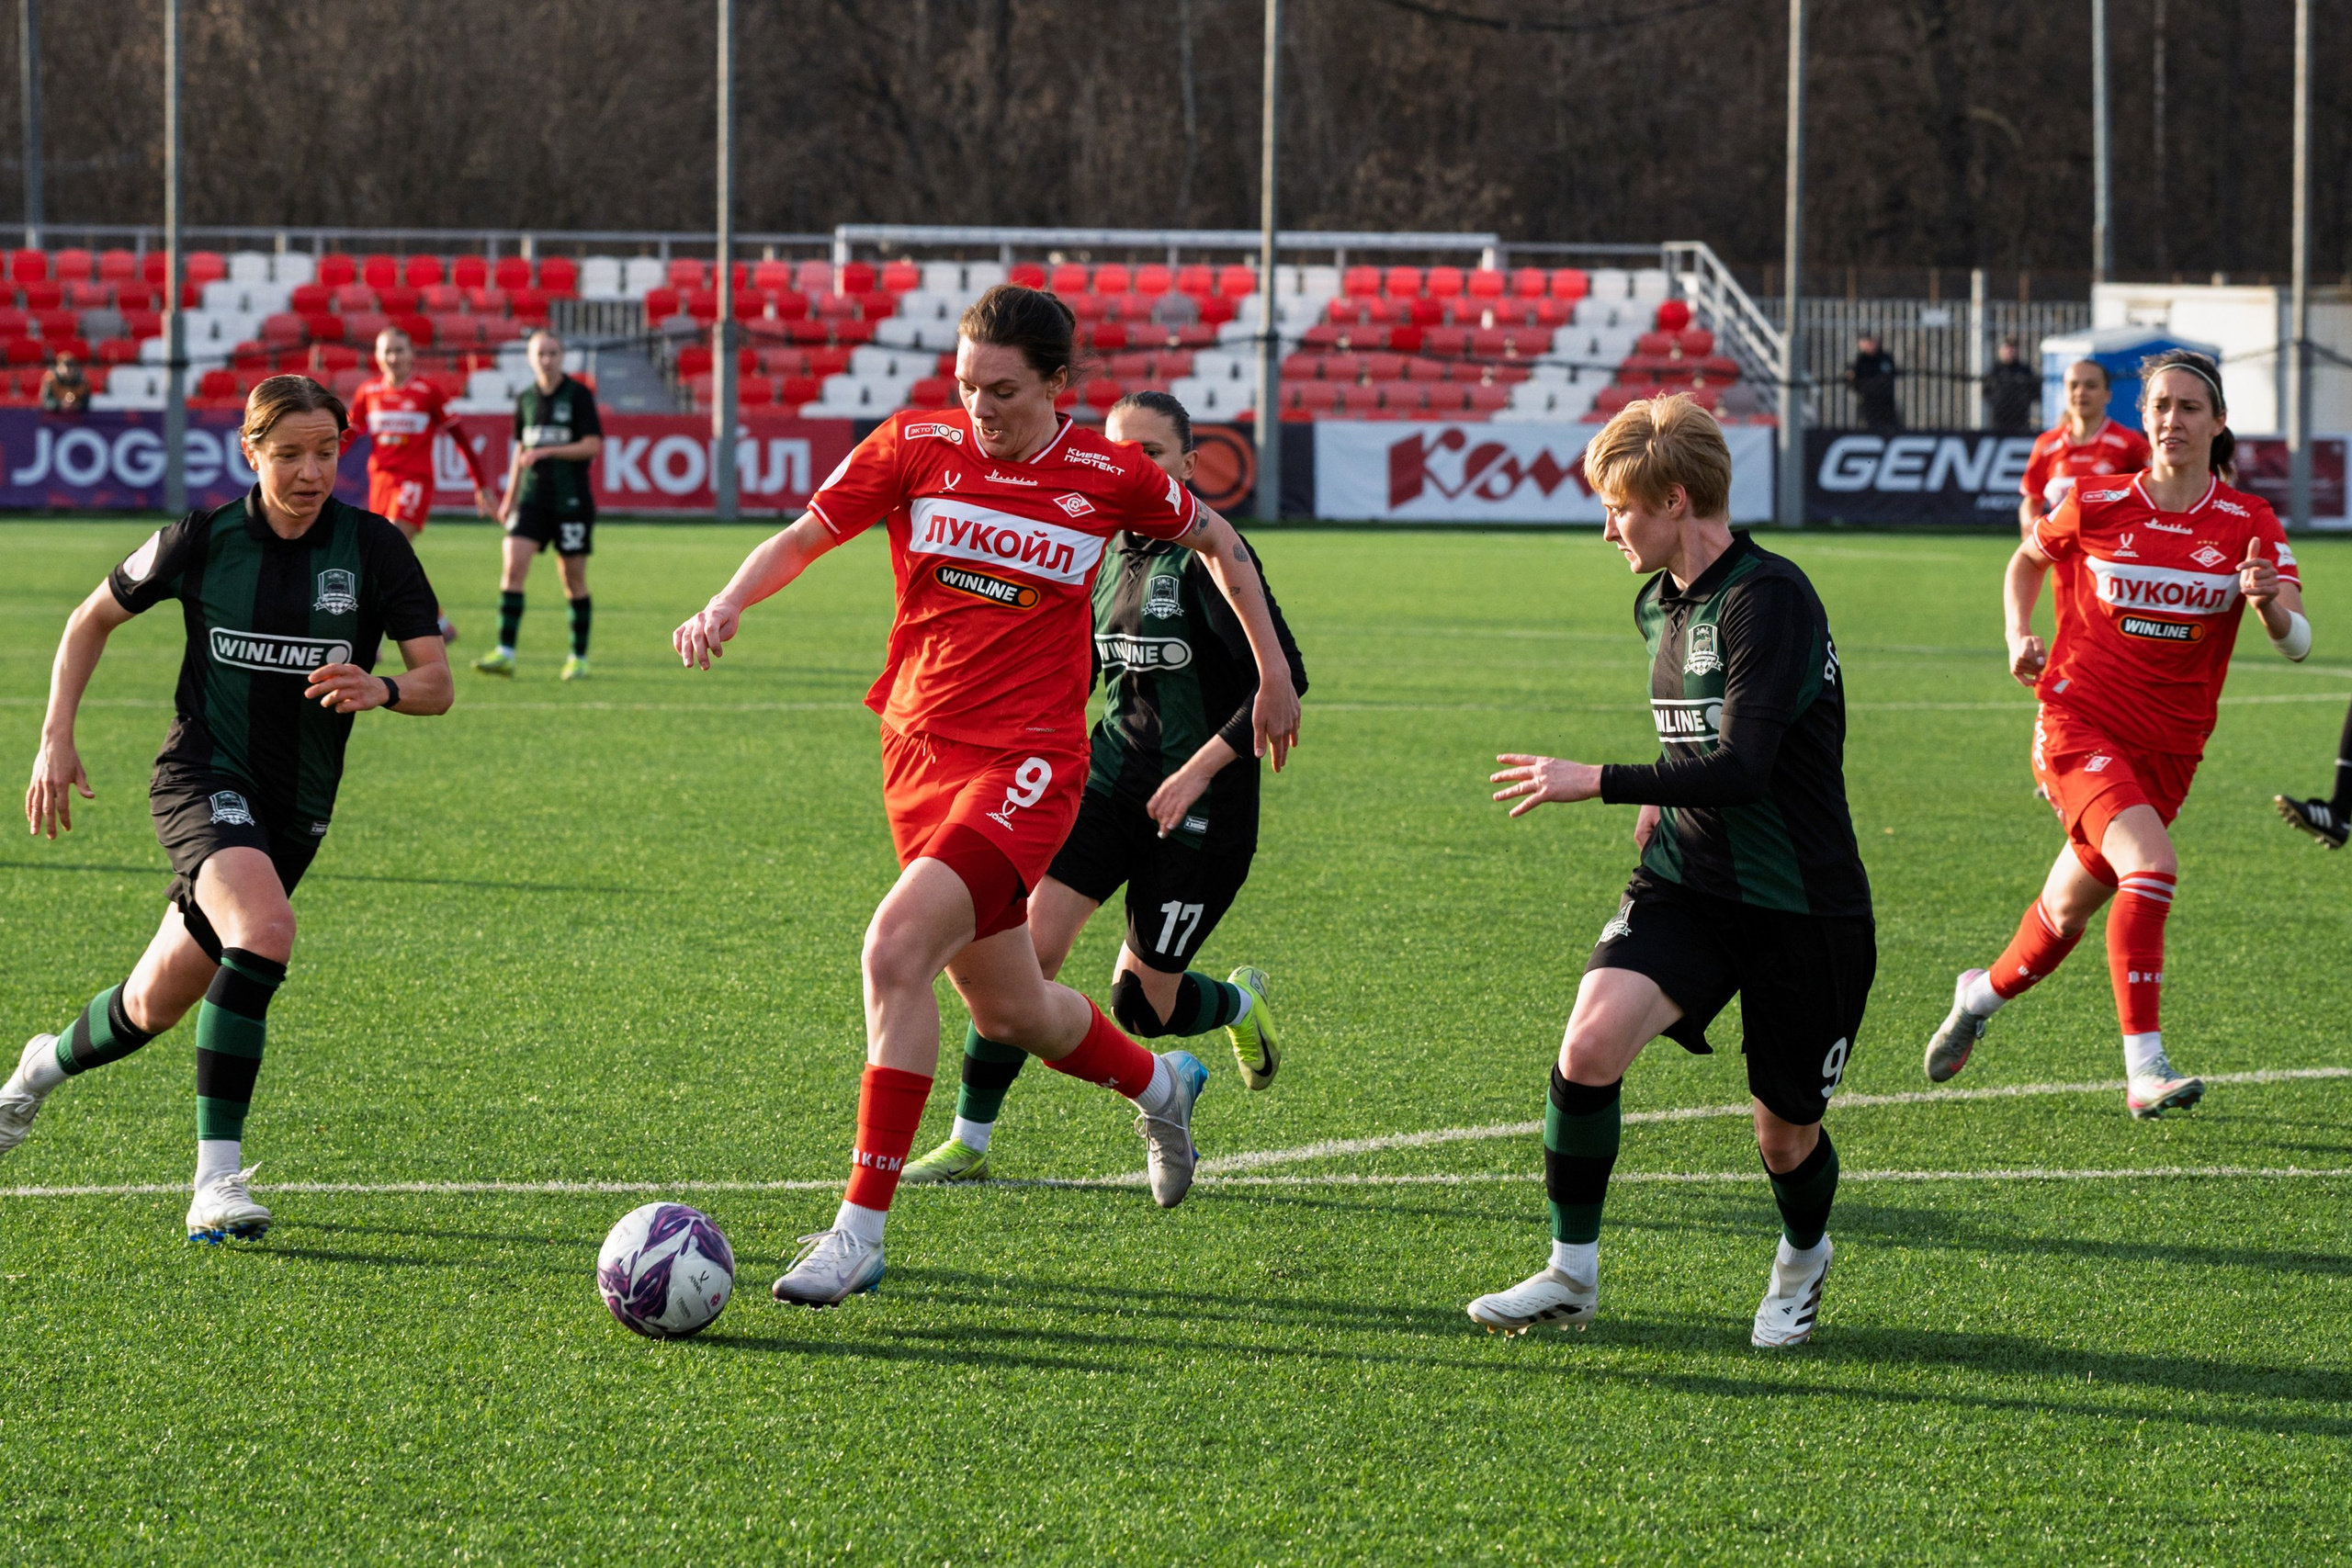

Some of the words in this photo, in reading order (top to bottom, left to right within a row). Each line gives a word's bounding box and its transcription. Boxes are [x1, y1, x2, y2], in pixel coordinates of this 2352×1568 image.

[1064, 454, 1125, 476] ПРОТЕКТ
[1067, 446, 1111, 461] КИБЕР
[925, 514, 1075, 575] ЛУКОЙЛ
[942, 569, 1018, 602] WINLINE
[2109, 576, 2227, 609] ЛУКОЙЛ
[2124, 618, 2189, 638] WINLINE
[217, 636, 325, 667] WINLINE
[1006, 756, 1053, 808] 9
[1155, 900, 1204, 957] 17
[1820, 1036, 1847, 1100] 9
